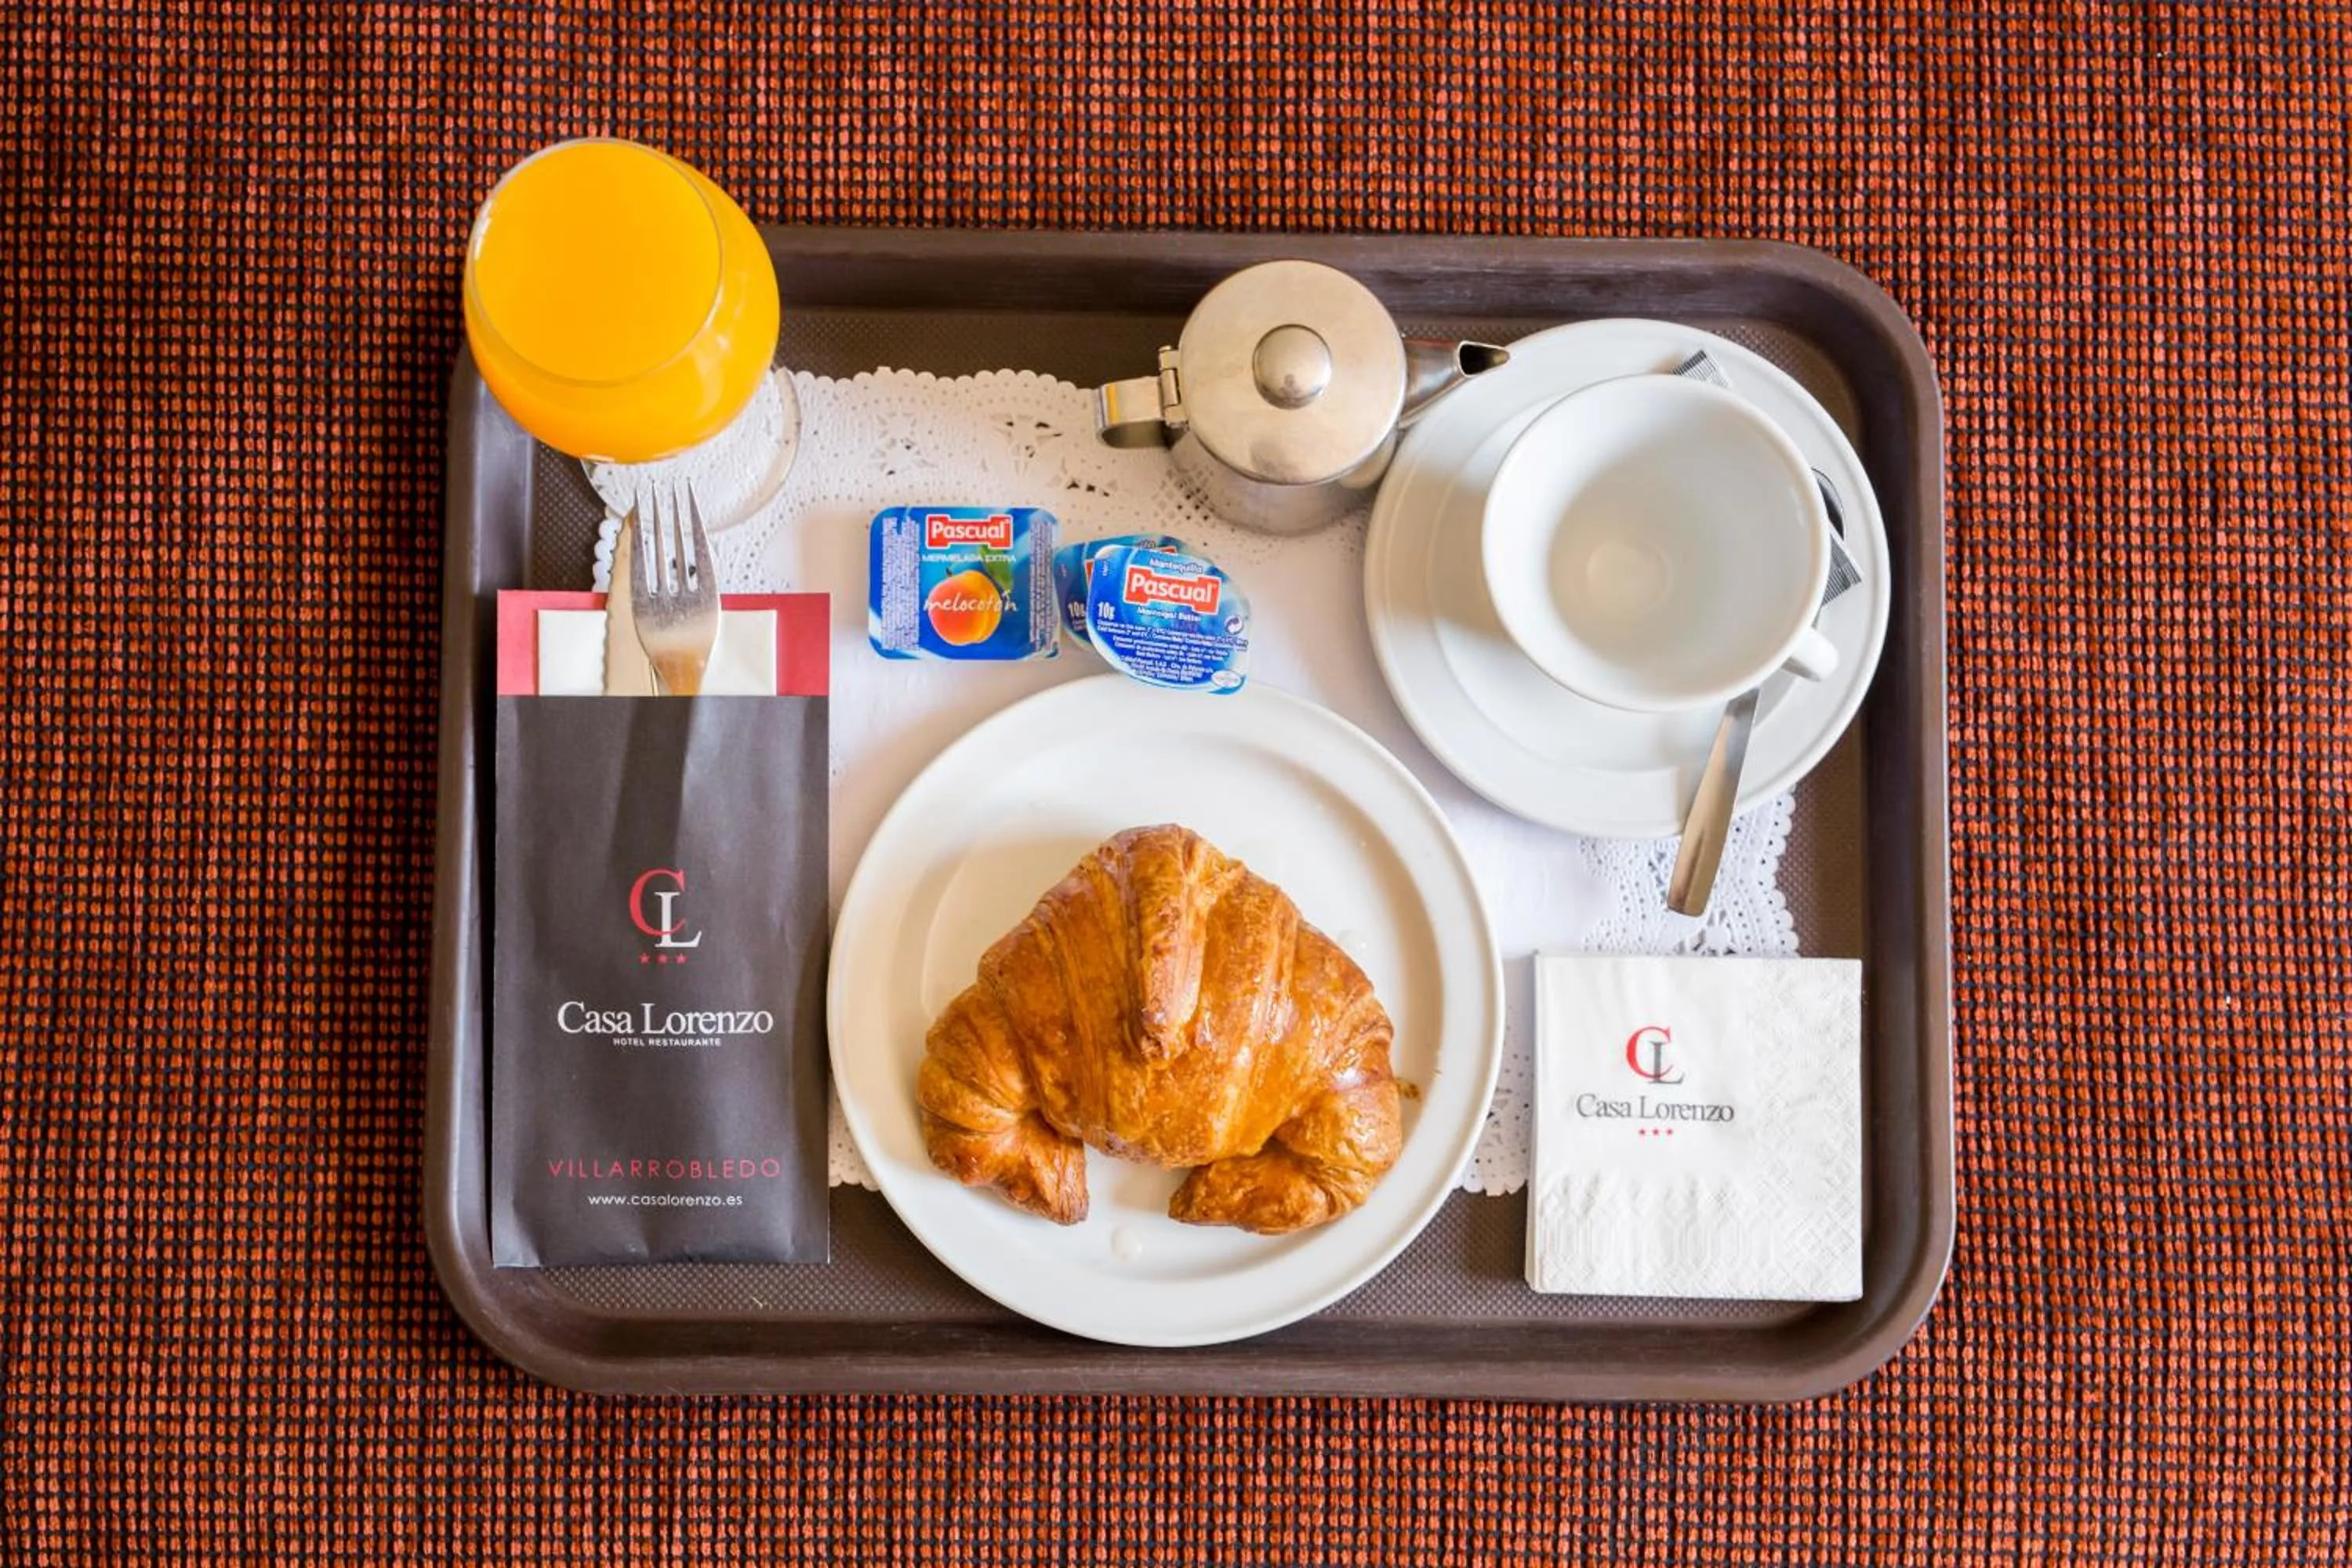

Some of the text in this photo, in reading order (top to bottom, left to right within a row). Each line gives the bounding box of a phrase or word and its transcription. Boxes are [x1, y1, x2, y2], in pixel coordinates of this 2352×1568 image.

[931, 520, 1005, 539] Pascual
[1149, 557, 1203, 576] Mantequilla
[1131, 572, 1214, 603] Pascual
[923, 590, 1018, 612] melocotón
[1098, 601, 1116, 620] 10g
[557, 1000, 774, 1035] Casa Lorenzo
[612, 1037, 722, 1047] HOTEL RESTAURANTE
[1576, 1092, 1735, 1123] Casa Lorenzo
[548, 1157, 781, 1179] VILLARROBLEDO
[587, 1192, 744, 1207] www.casalorenzo.es
